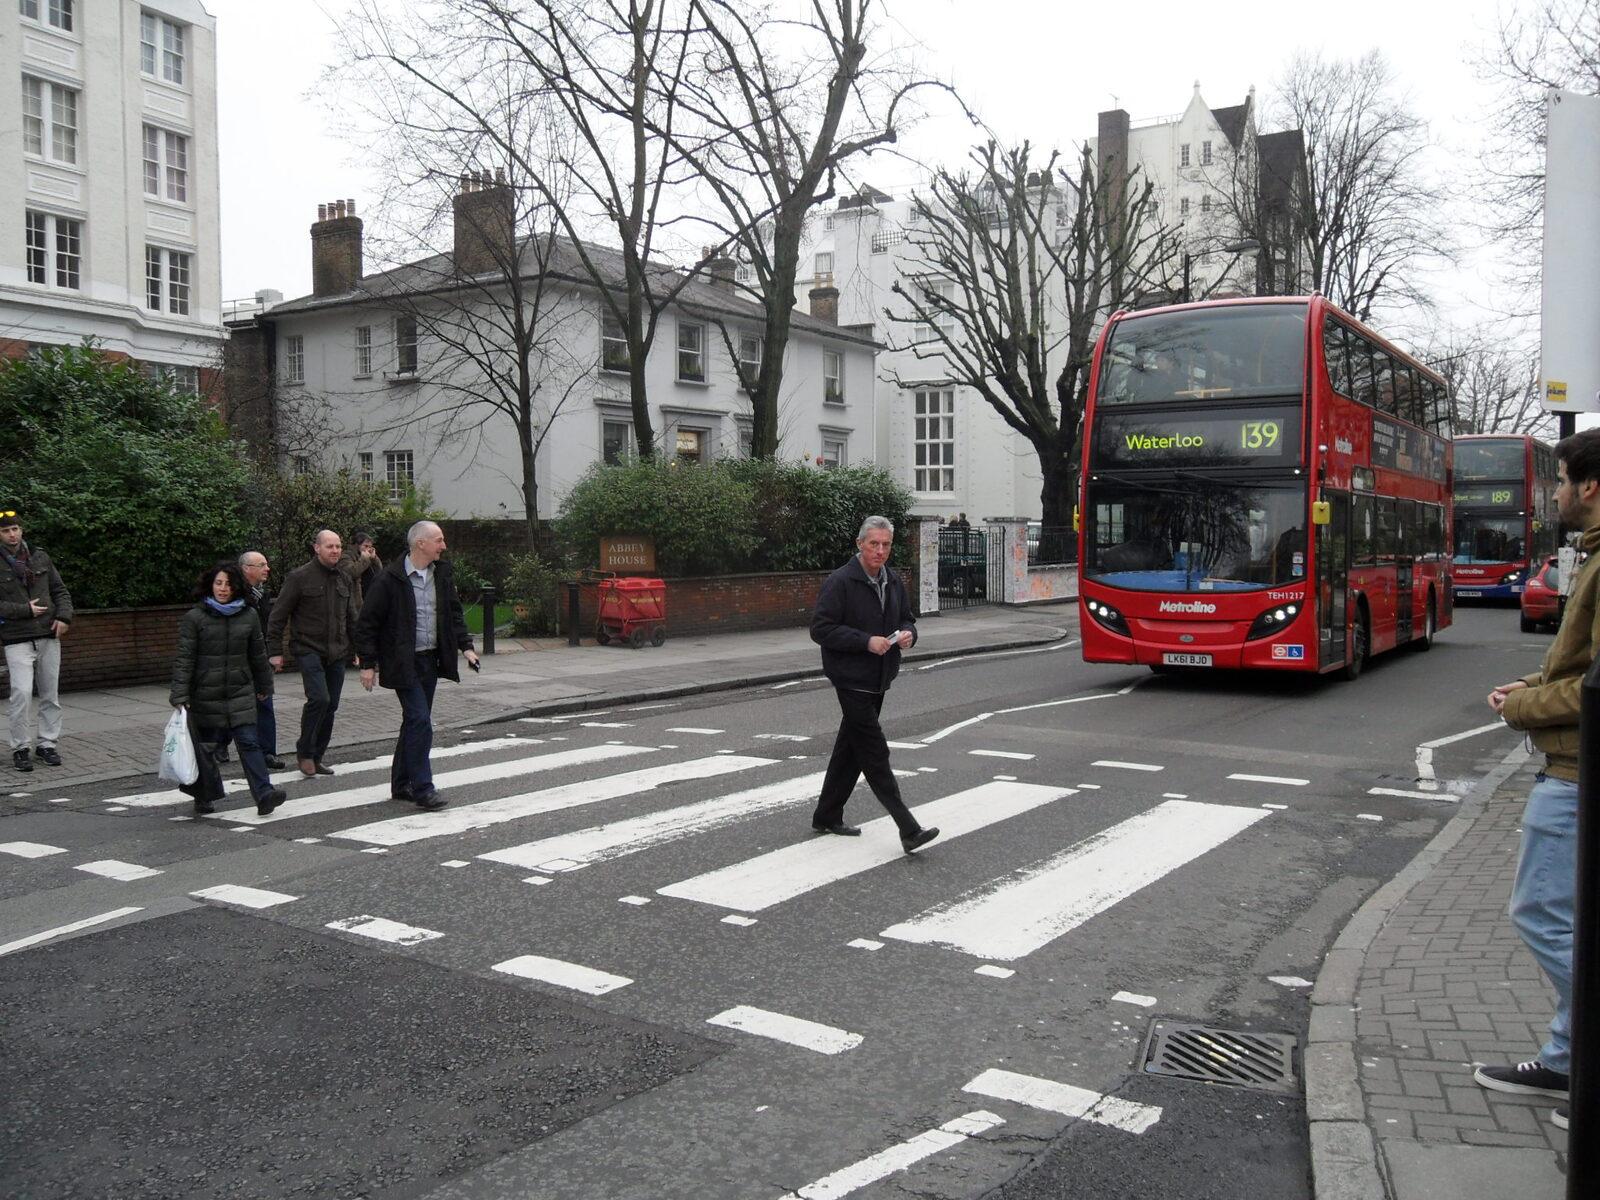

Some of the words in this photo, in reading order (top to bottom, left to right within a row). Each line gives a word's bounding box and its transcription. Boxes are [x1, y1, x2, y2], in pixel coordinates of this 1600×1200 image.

[1125, 433, 1204, 449] Waterloo
[1241, 422, 1279, 449] 139
[1492, 490, 1511, 503] 189
[608, 543, 646, 553] ABBEY
[608, 555, 647, 565] HOUSE
[1267, 591, 1305, 600] TEH1217
[1159, 600, 1217, 614] Metroline
[1167, 654, 1188, 664] LK61
